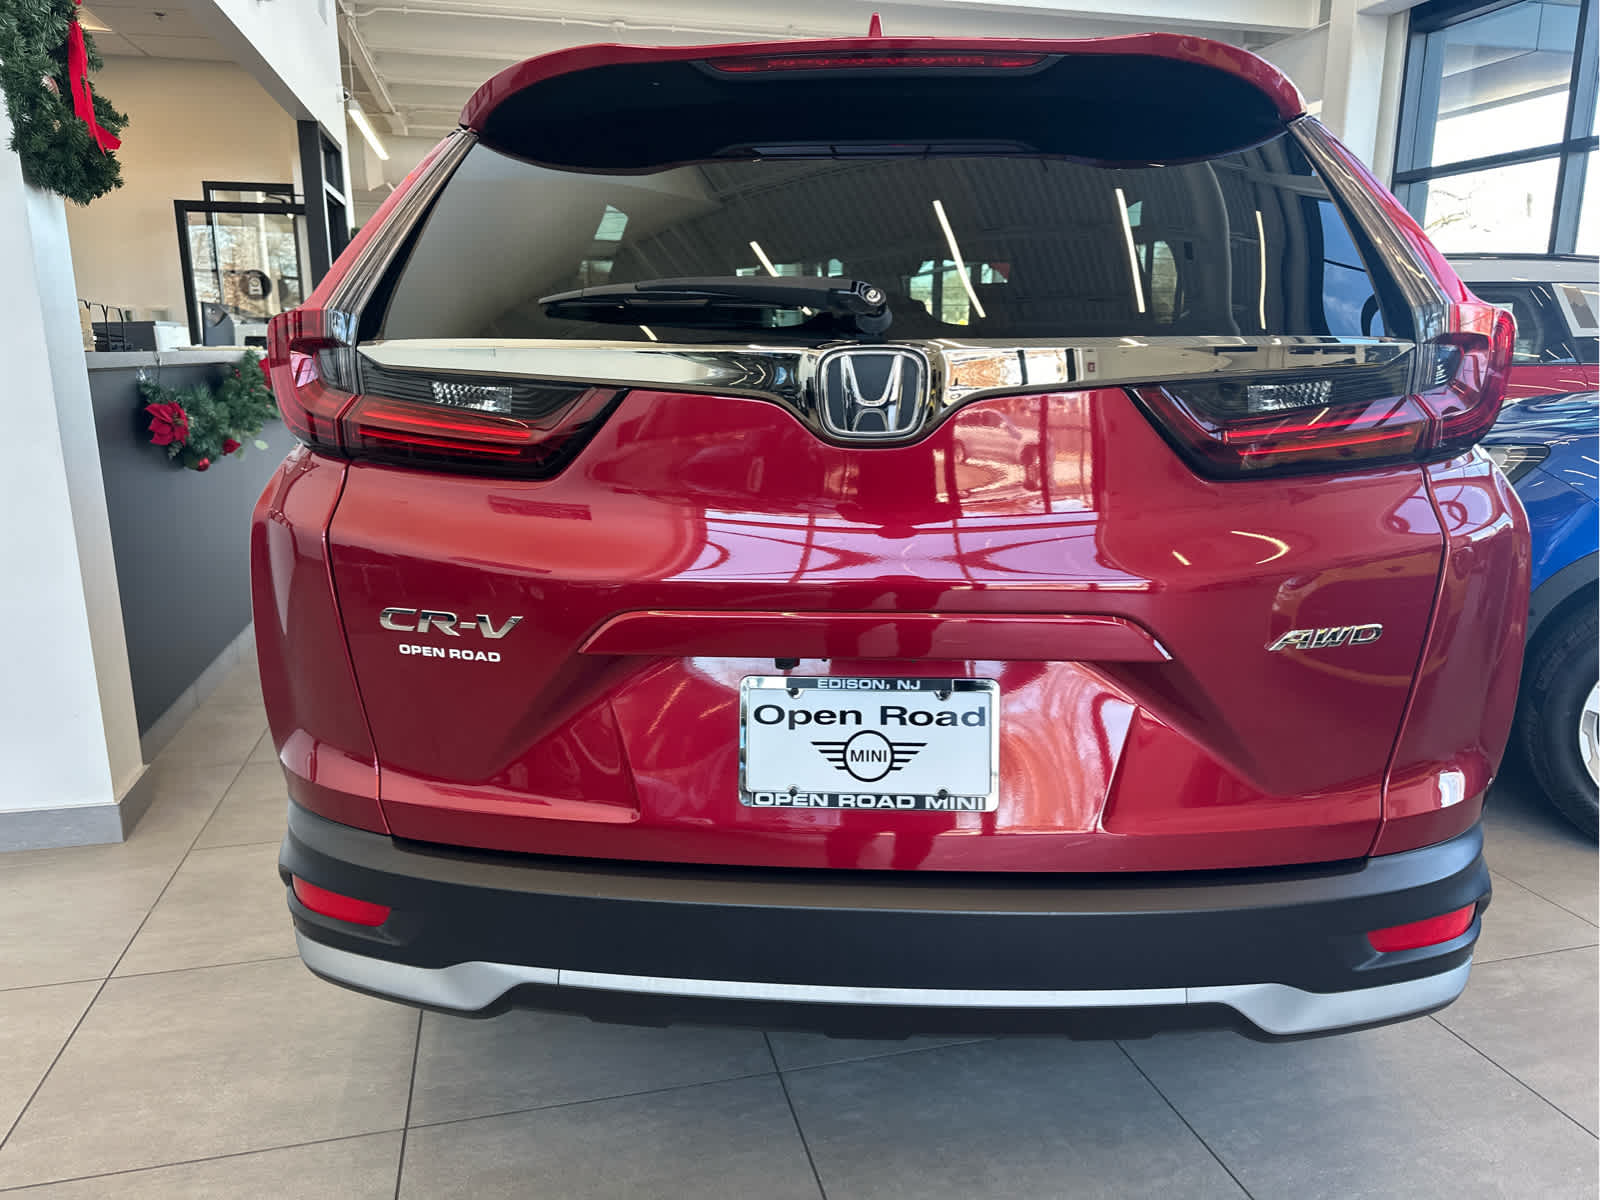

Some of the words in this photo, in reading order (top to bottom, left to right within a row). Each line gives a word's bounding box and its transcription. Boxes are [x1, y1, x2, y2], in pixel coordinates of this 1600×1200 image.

[379, 606, 524, 639] CR-V
[1266, 623, 1384, 651] AWD
[399, 643, 446, 658] OPEN
[449, 648, 501, 663] ROAD
[817, 678, 891, 690] EDISON,
[897, 679, 921, 690] NJ
[753, 704, 862, 730] Open
[880, 705, 986, 727] Road
[850, 749, 887, 763] MINI
[755, 792, 829, 807] OPEN
[838, 793, 915, 809] ROAD
[925, 795, 984, 810] MINI
